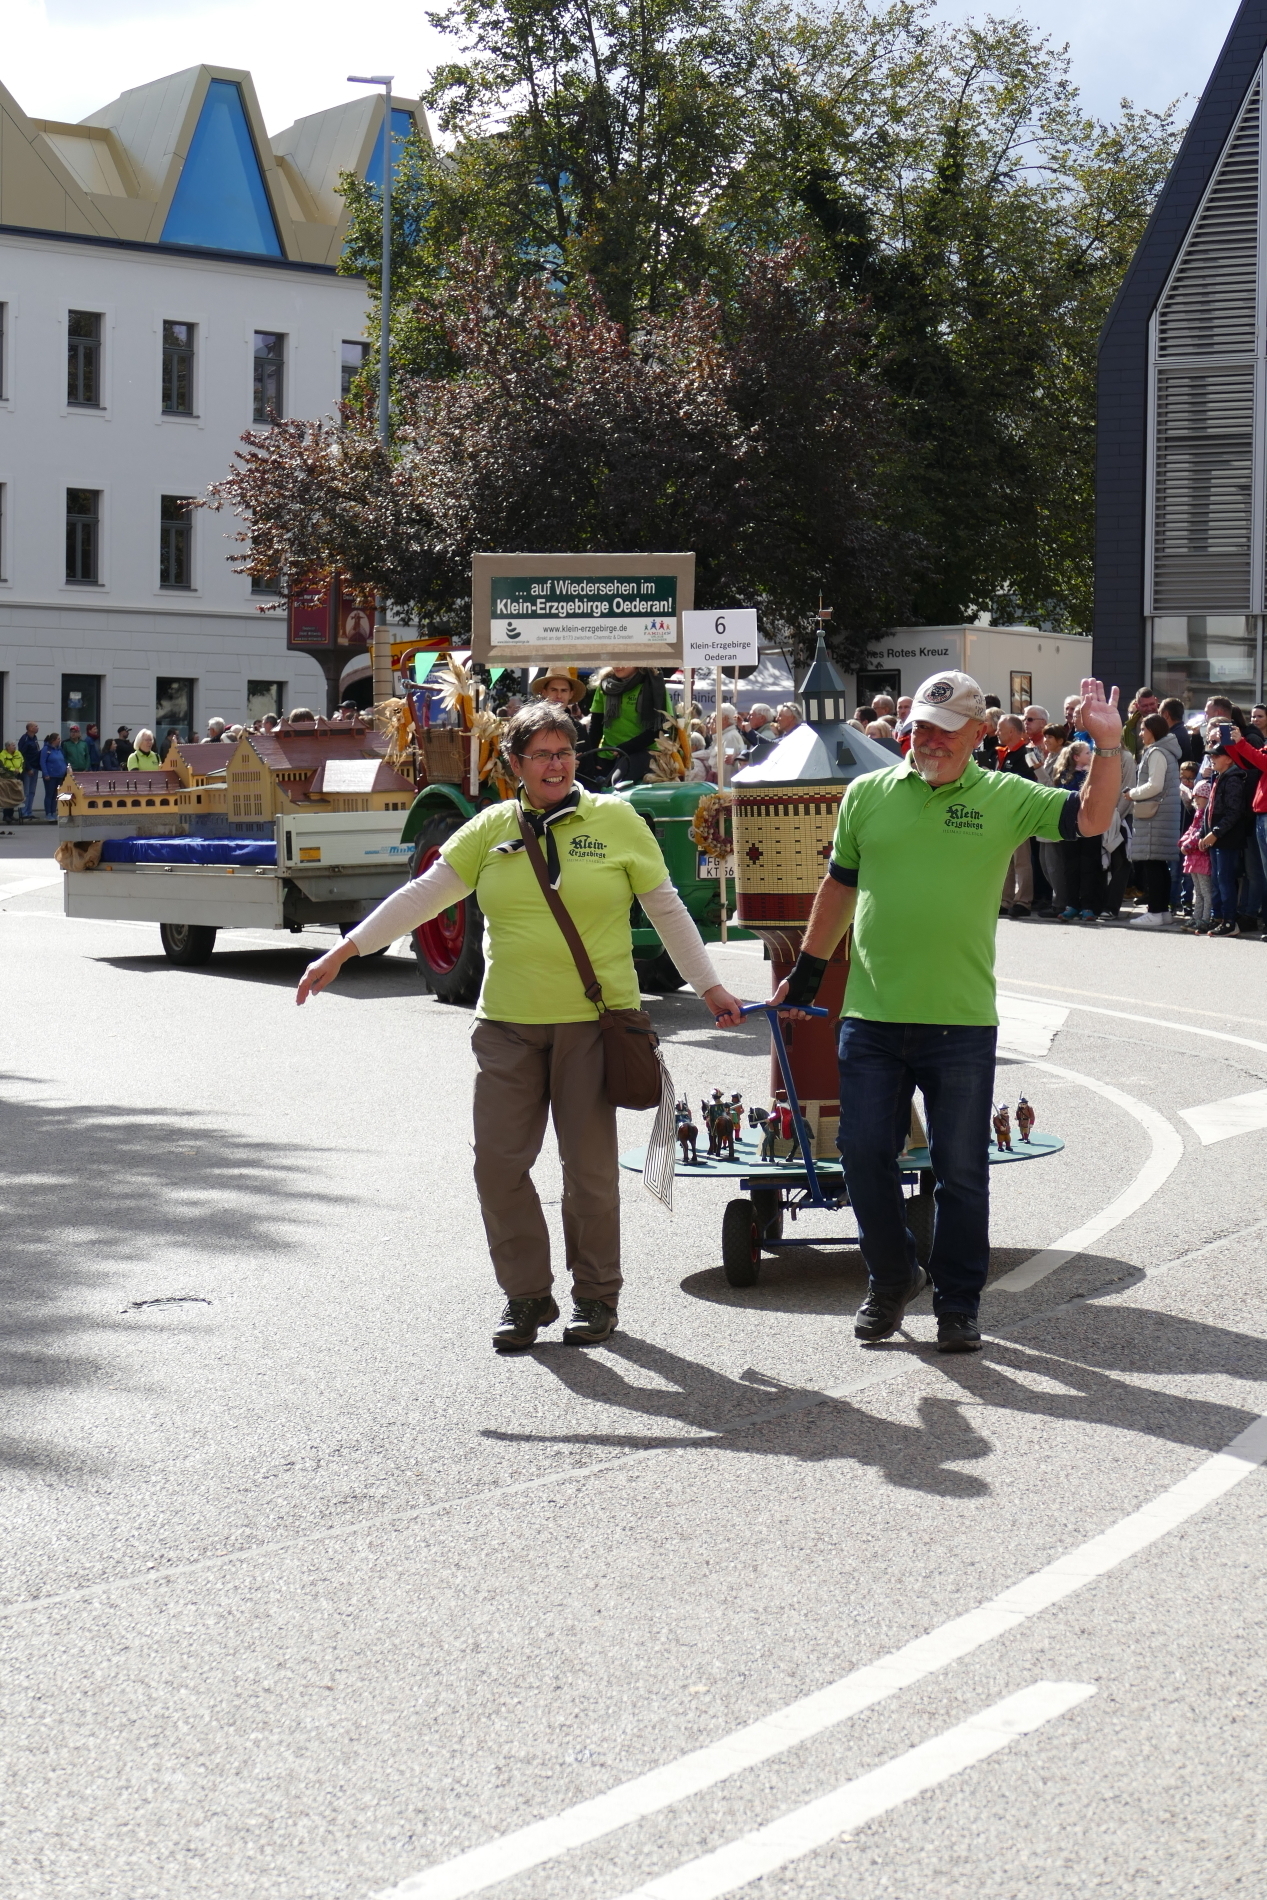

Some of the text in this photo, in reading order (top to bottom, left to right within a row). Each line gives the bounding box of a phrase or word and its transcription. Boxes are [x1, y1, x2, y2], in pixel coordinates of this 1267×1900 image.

[531, 581, 551, 595] auf
[554, 580, 637, 595] Wiedersehen
[640, 580, 656, 594] im
[496, 598, 672, 617] Klein-Erzgebirge Oederan!
[543, 624, 628, 634] www.klein-erzgebirge.de
[715, 616, 726, 634] 6
[690, 641, 751, 650] Klein-Erzgebirge
[704, 653, 737, 661] Oederan
[887, 648, 916, 658] Rotes
[919, 647, 949, 657] Kreuz
[946, 804, 983, 819] Klein-
[944, 819, 983, 830] Erzgebirge
[570, 835, 607, 850] Klein-
[568, 849, 606, 858] Erzgebirge
[707, 857, 720, 866] FG
[707, 867, 719, 877] KT
